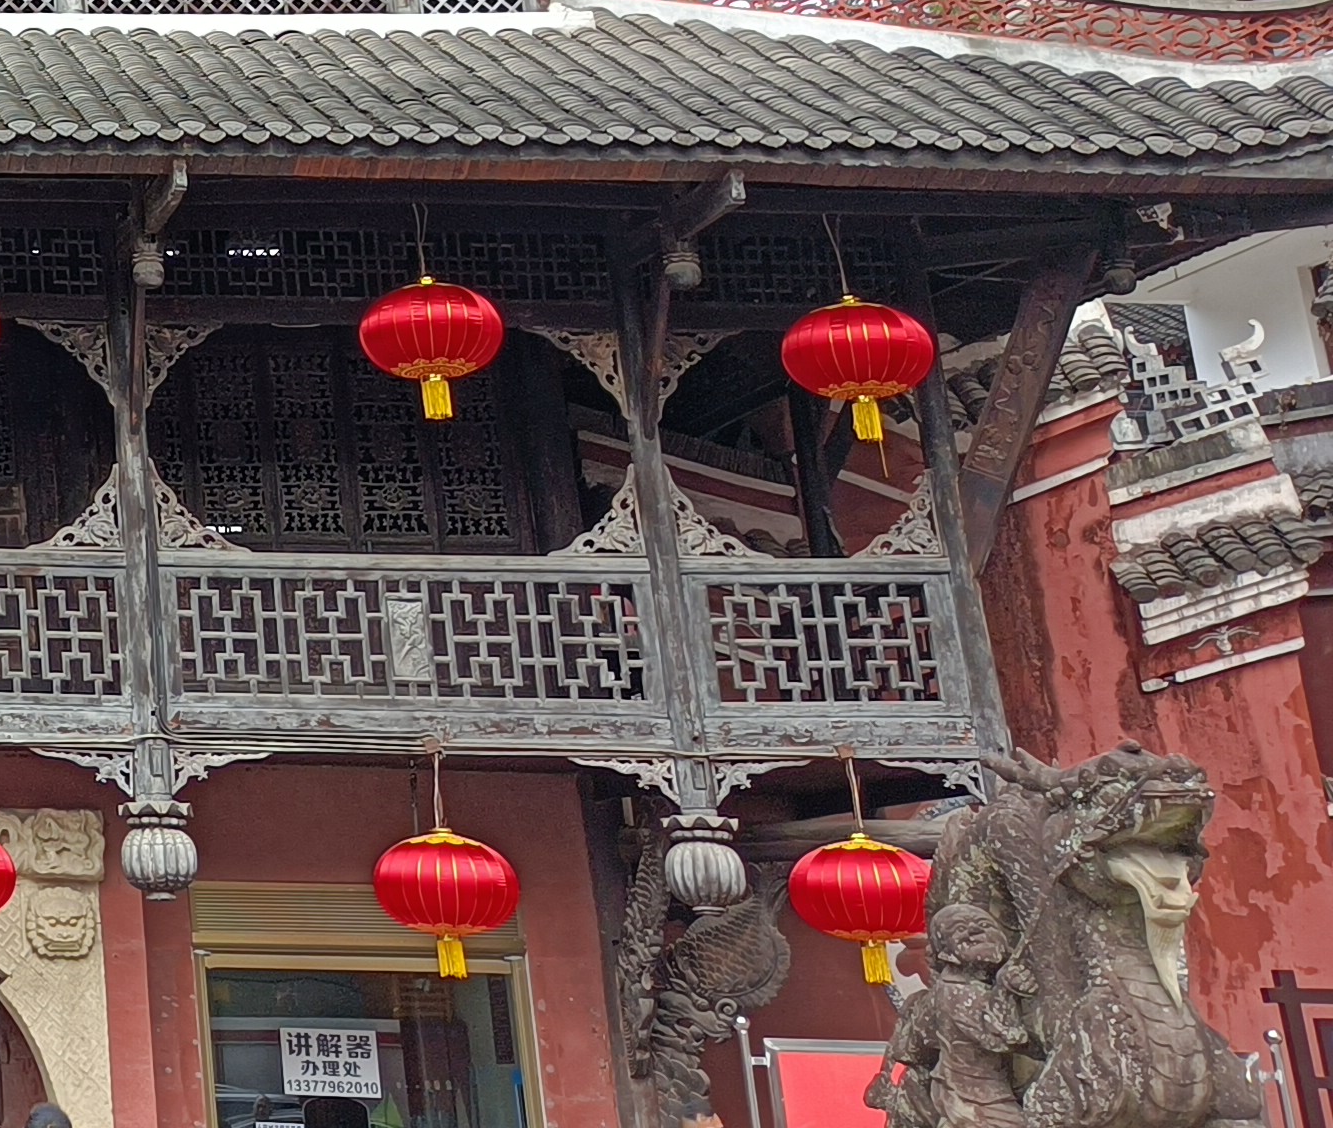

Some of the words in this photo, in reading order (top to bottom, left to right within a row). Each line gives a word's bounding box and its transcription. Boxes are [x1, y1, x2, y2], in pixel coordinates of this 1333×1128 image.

[286, 1032, 372, 1059] 讲解器
[301, 1059, 361, 1078] 办理处
[286, 1079, 379, 1094] 13377962010
